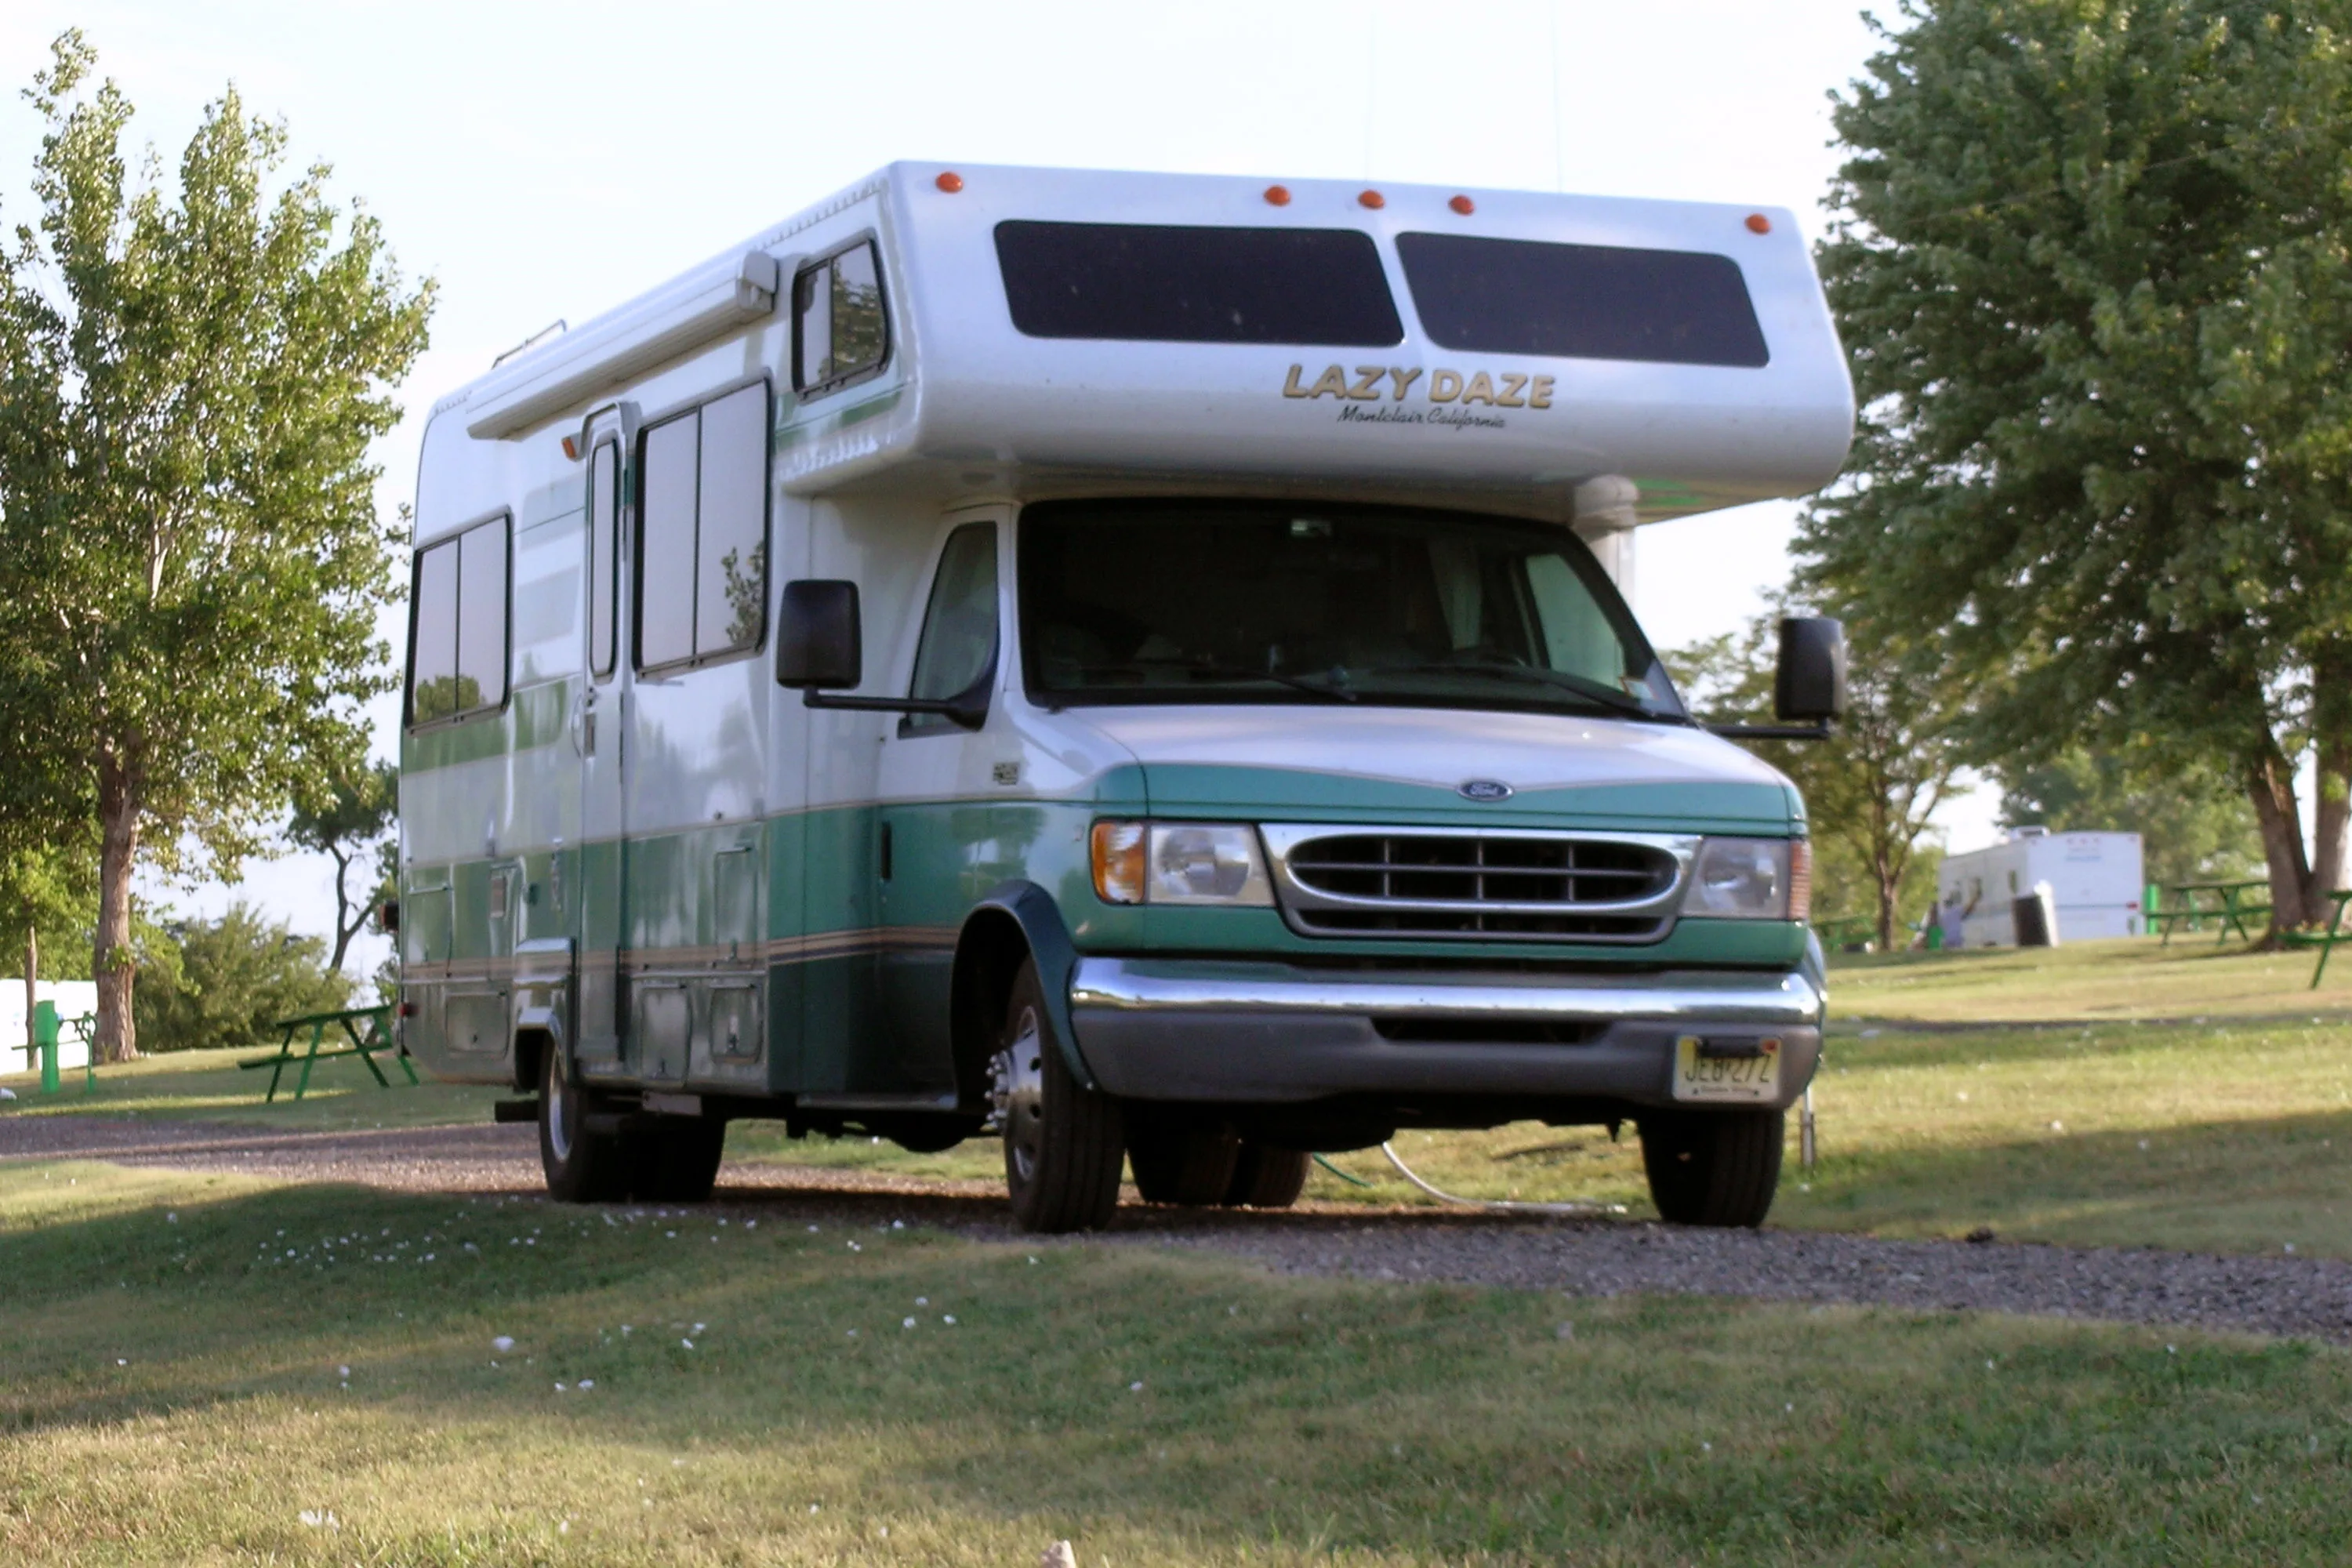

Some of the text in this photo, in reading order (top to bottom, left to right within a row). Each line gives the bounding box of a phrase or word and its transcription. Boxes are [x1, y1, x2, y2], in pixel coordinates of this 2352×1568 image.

[1283, 364, 1555, 408] LAZY DAZE
[1337, 405, 1506, 431] Montclair California
